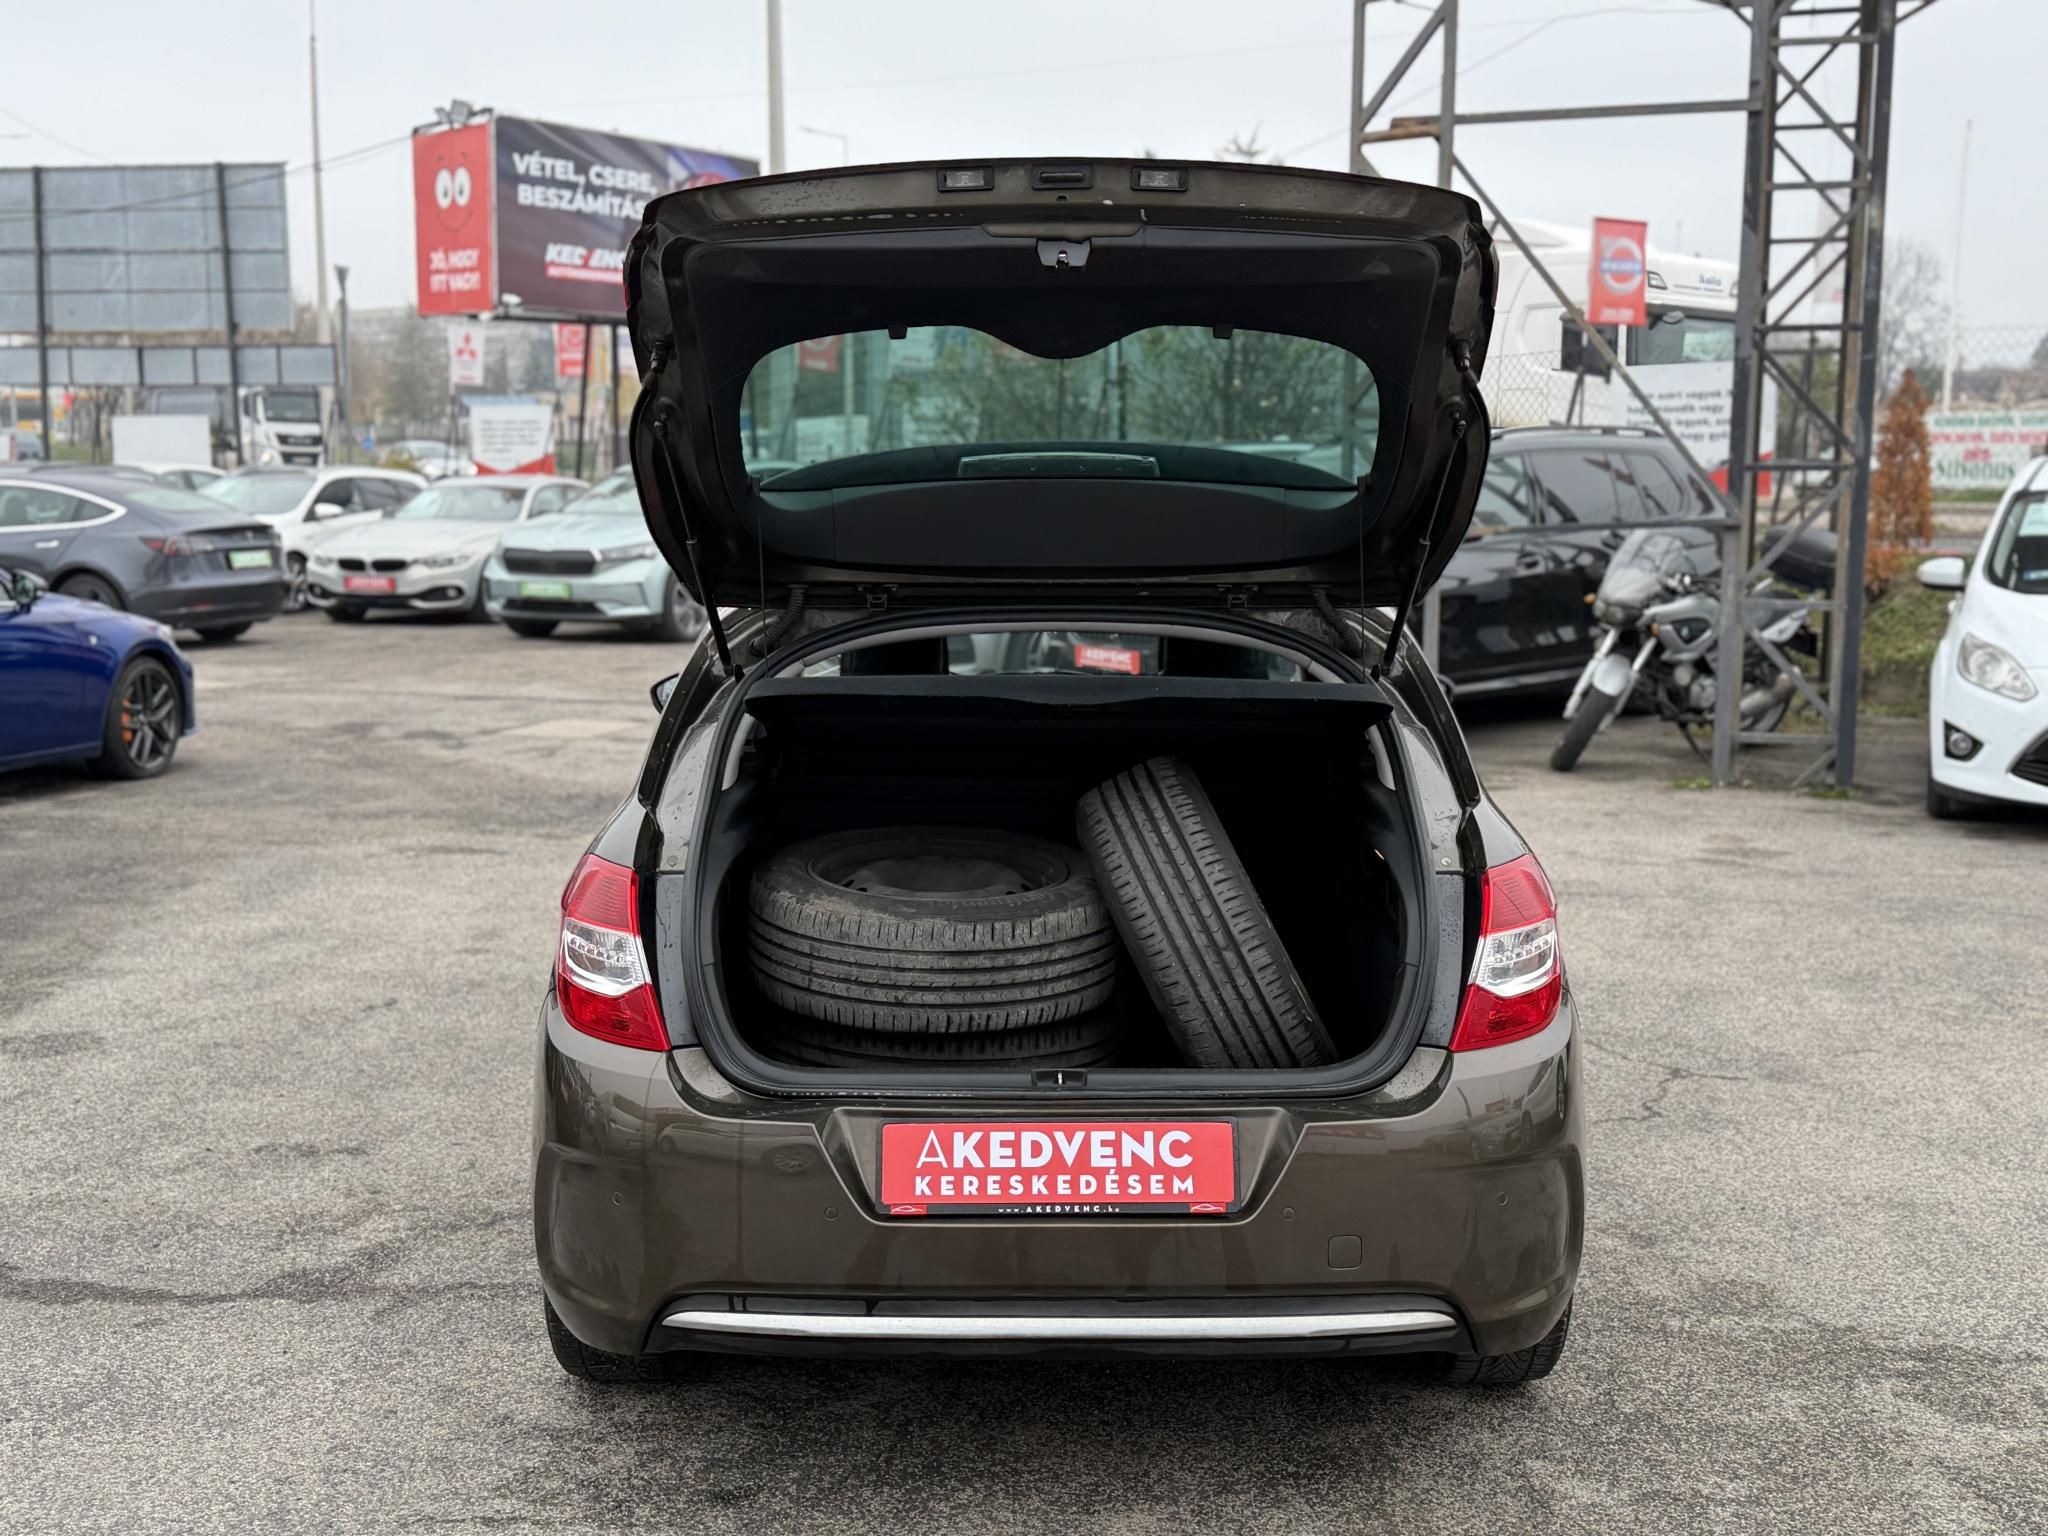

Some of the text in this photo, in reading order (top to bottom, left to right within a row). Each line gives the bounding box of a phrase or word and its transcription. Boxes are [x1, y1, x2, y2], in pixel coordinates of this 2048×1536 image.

[512, 150, 657, 195] VÉTEL, CSERE,
[914, 1168, 1194, 1197] KERESKEDÉSEM
